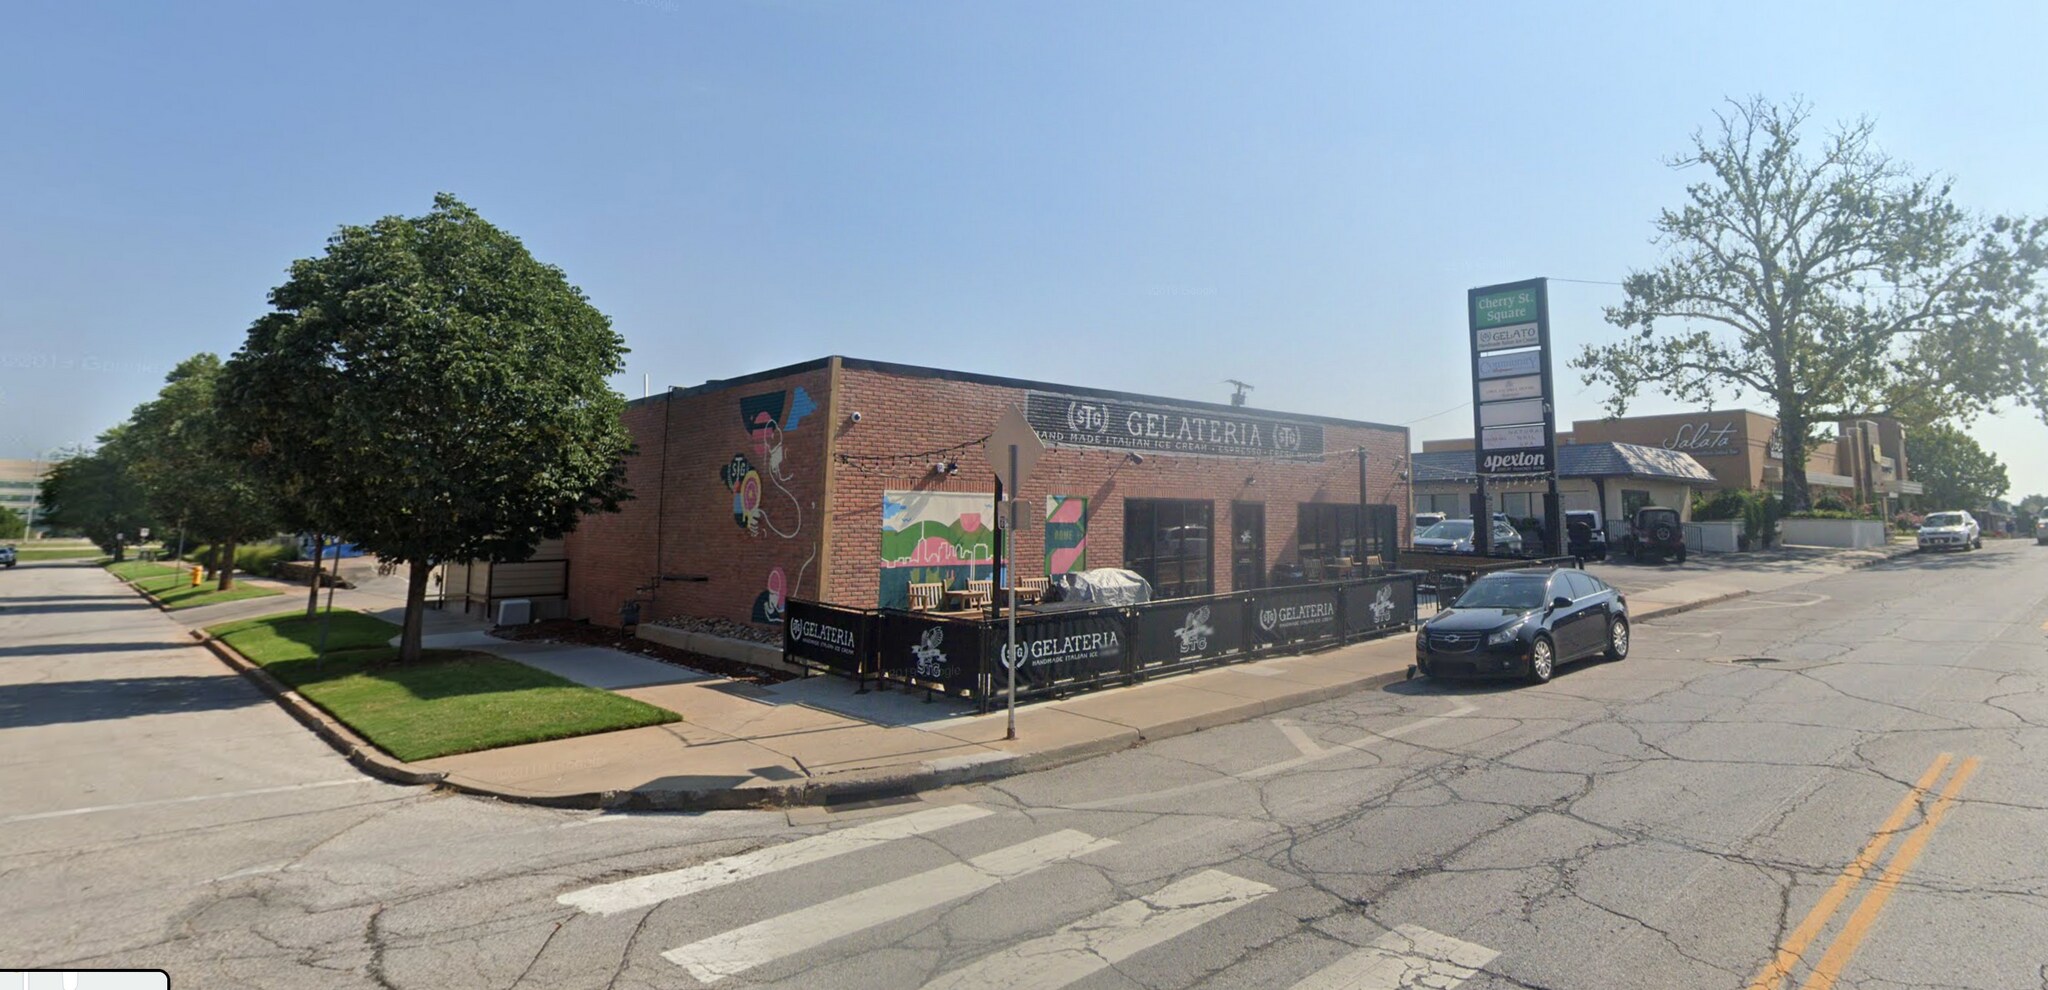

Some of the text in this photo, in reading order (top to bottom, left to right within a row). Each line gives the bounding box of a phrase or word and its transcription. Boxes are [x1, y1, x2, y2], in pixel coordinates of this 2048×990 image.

[1478, 293, 1534, 310] Cherry St.
[1487, 307, 1526, 322] Square
[1492, 327, 1536, 342] GELATO
[1127, 411, 1263, 447] GELATERIA
[1662, 421, 1738, 450] Salata
[1070, 433, 1101, 444] MADE
[1105, 435, 1151, 447] ITALIAN
[1154, 441, 1171, 449] ICE
[1175, 441, 1207, 451] CREAM
[1218, 445, 1262, 456] ESPRESSO
[1483, 451, 1545, 472] spexton
[1278, 602, 1334, 622] GELATERIA
[803, 621, 855, 648] GELATERIA
[1031, 631, 1119, 658] GELATERIA
[1180, 637, 1207, 654] STG
[1031, 657, 1065, 667] HANDMADE
[1065, 653, 1088, 662] ITALIAN
[1089, 651, 1098, 659] ICE
[916, 661, 941, 678] STG
